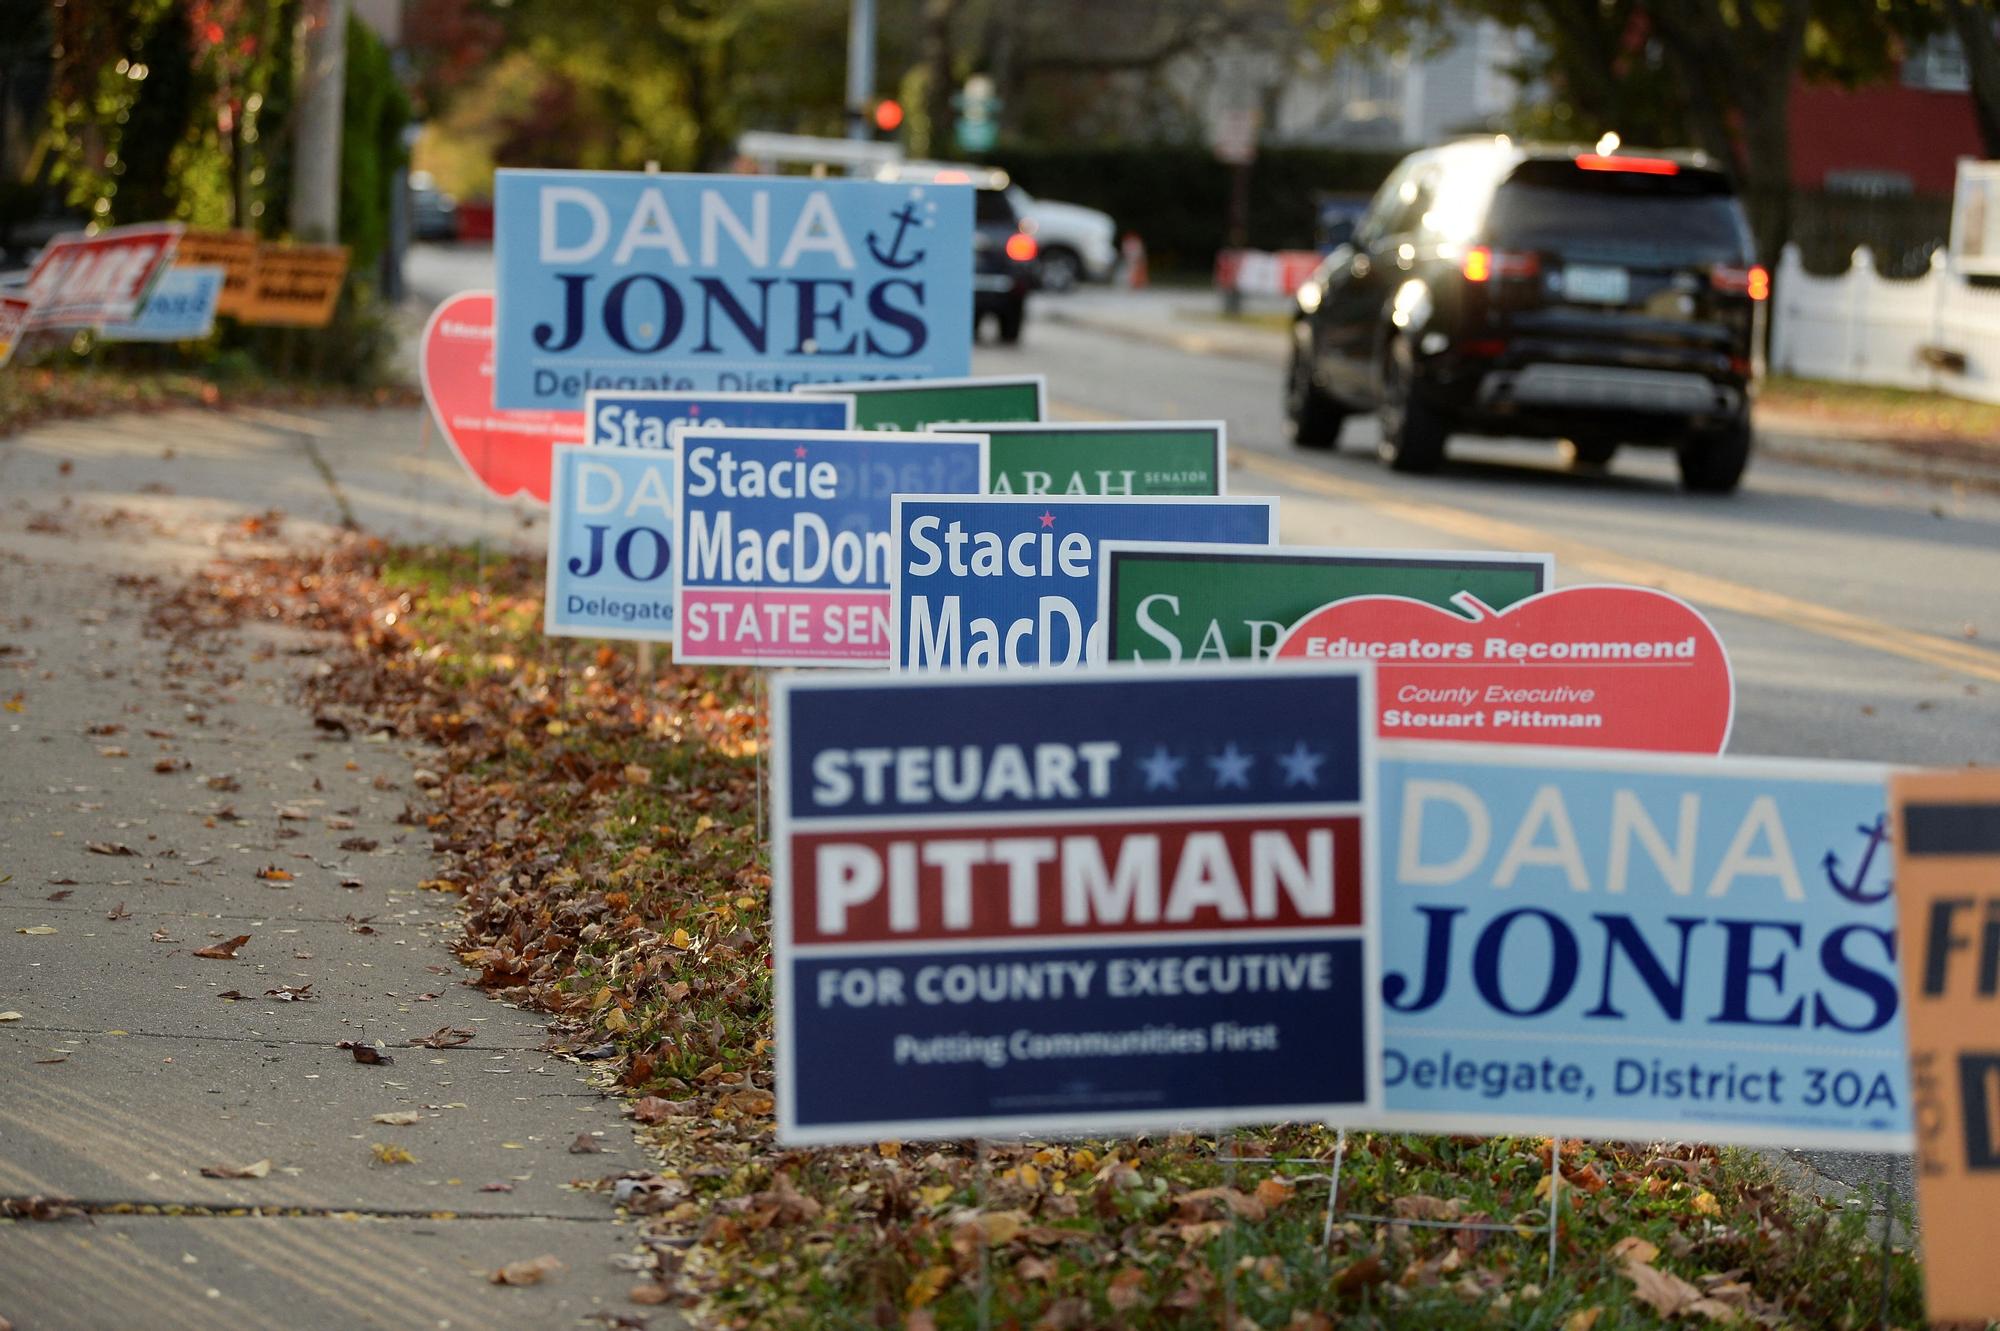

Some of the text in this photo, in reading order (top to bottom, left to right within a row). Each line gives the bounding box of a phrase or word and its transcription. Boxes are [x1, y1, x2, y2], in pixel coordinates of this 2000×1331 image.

[539, 185, 856, 269] DANA
[532, 272, 929, 358] JONES
[688, 445, 839, 499] Stacie
[1144, 471, 1208, 483] SENATOR
[568, 524, 671, 582] JO
[908, 511, 1093, 578] Stacie
[567, 594, 674, 622] Delegate
[687, 602, 812, 644] STATE
[1305, 636, 1696, 659] Educators Recommend
[1382, 709, 1602, 729] Steuart Pittman
[1398, 684, 1595, 707] County Executive
[812, 741, 1121, 806] STEUART
[1395, 777, 1805, 902] DANA
[815, 828, 1335, 936] PITTMAN
[817, 952, 1333, 1008] FOR COUNTY EXECUTIVE
[1380, 904, 1899, 1036] JONES
[894, 1022, 1278, 1069] Putting Communities First
[1382, 1048, 1897, 1111] Delegate, District 30A
